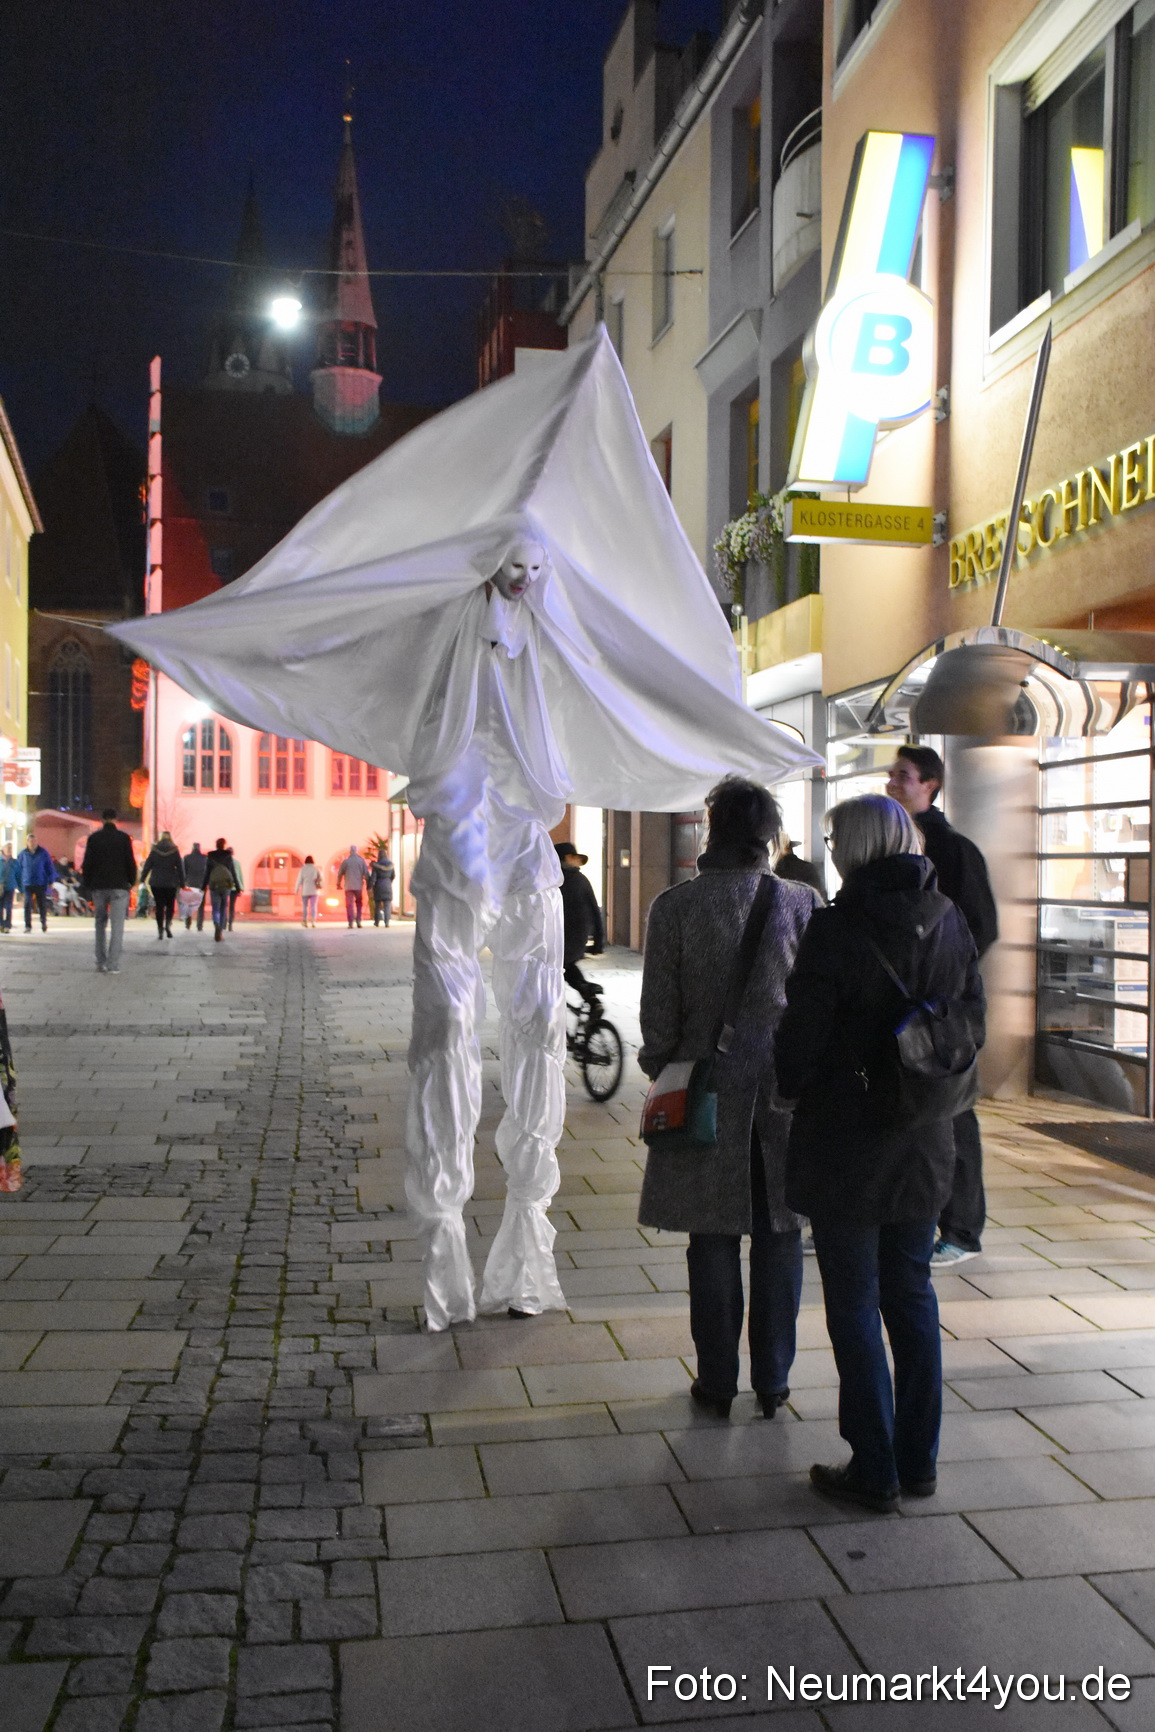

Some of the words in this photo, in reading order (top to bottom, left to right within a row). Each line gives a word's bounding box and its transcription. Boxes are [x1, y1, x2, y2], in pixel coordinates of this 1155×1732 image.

[851, 312, 912, 376] B
[800, 510, 911, 531] KLOSTERGASSE
[917, 517, 925, 531] 4
